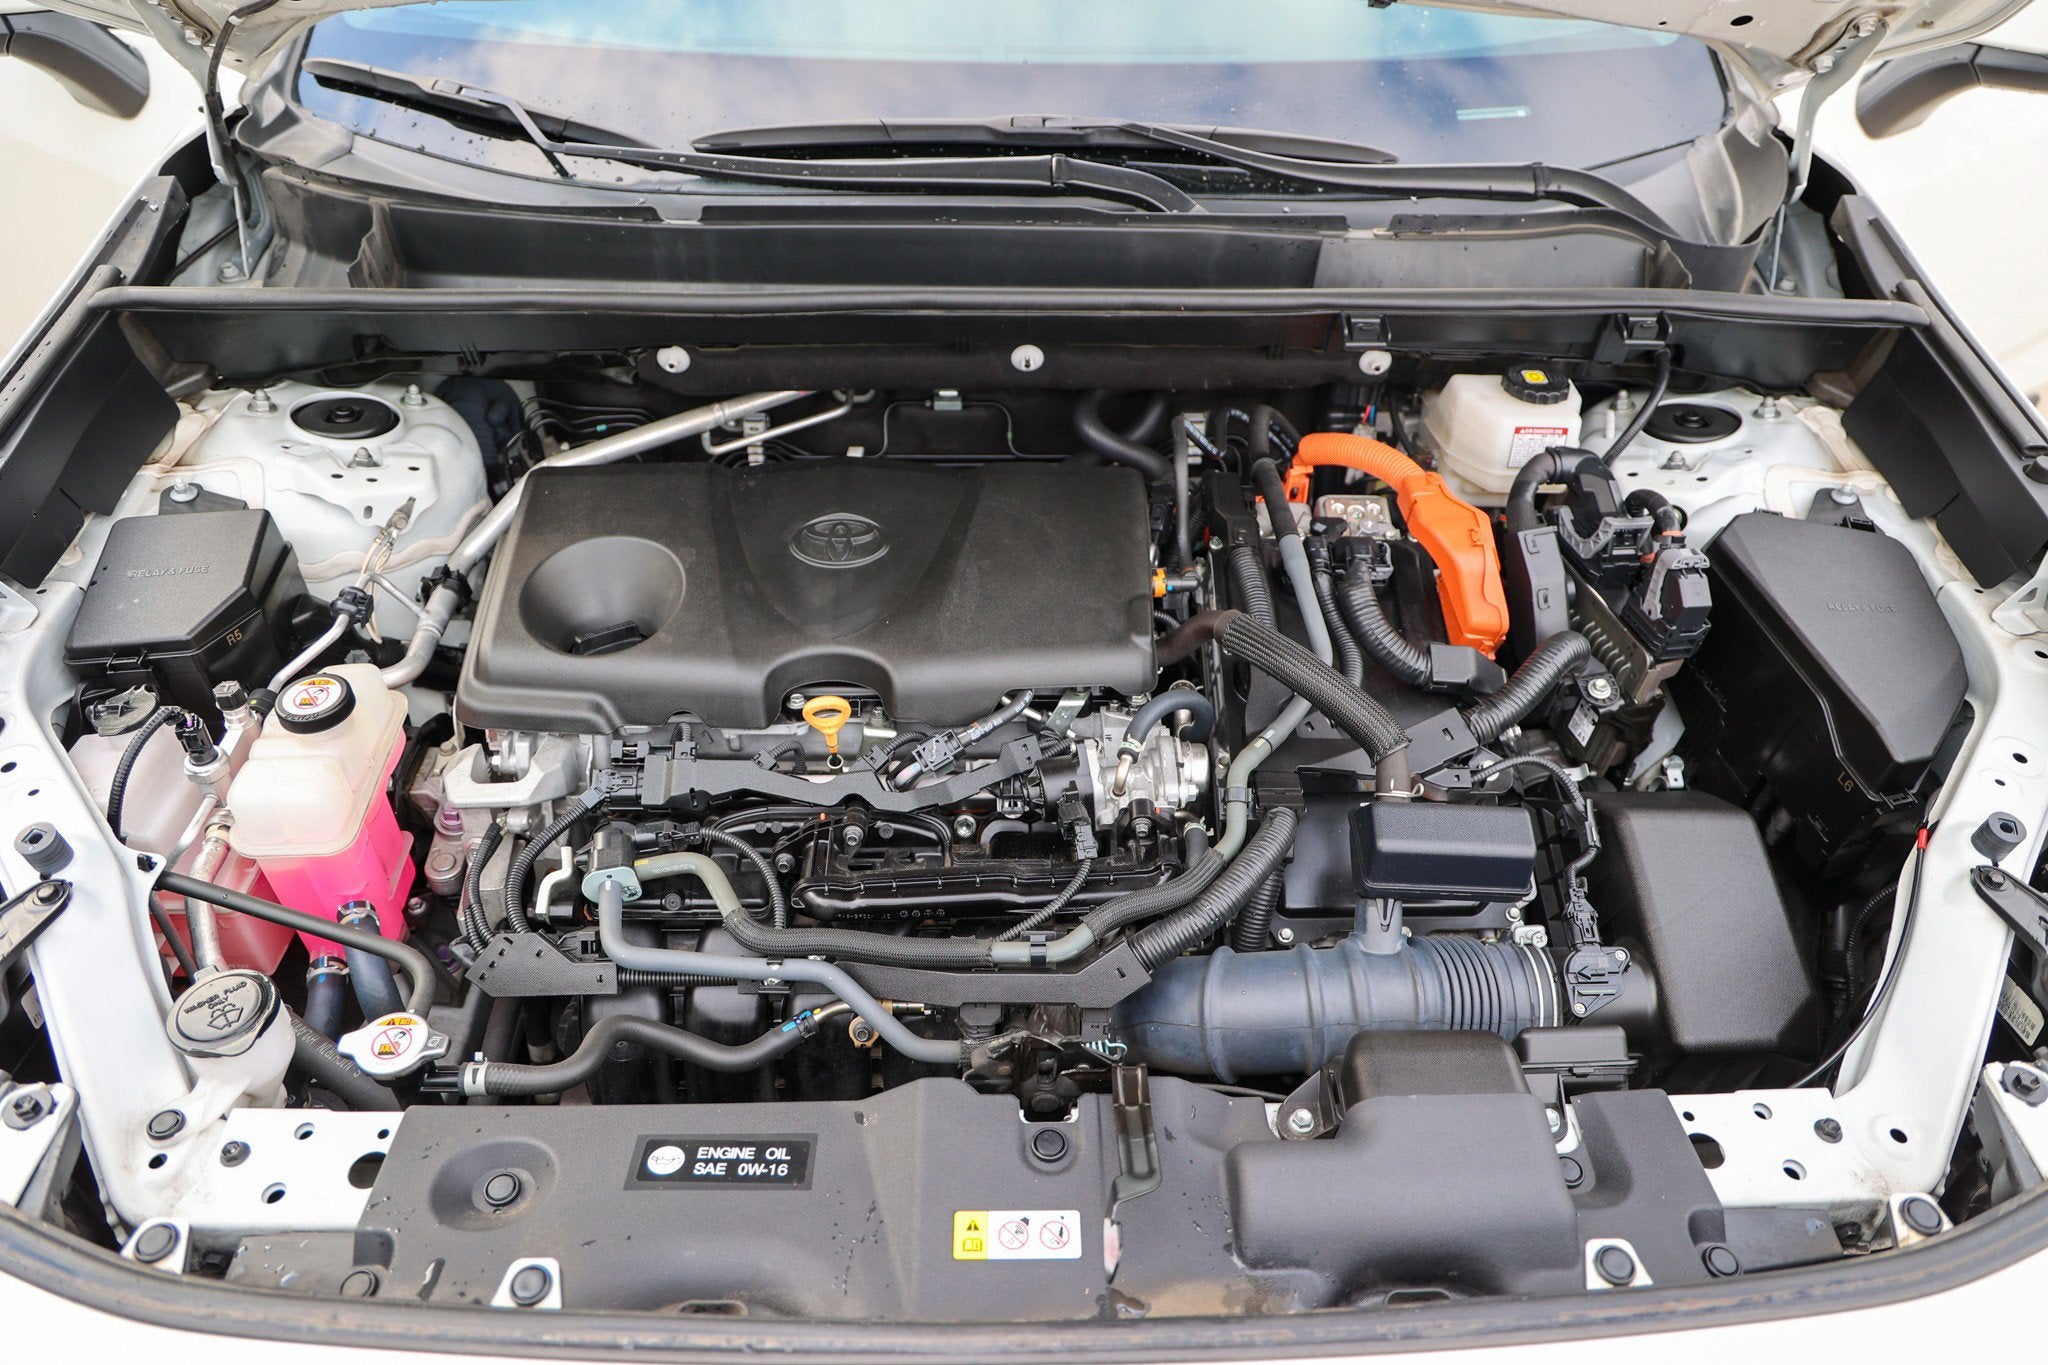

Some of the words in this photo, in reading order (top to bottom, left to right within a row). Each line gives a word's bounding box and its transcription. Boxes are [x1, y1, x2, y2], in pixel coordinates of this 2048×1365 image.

[179, 565, 209, 575] FUSE
[226, 628, 242, 646] R5
[1838, 771, 1853, 792] L6
[184, 994, 220, 1014] WASHER
[224, 981, 247, 995] FLUID
[207, 996, 229, 1010] ONLY
[697, 1147, 756, 1160] ENGINE
[765, 1147, 791, 1160] OIL
[693, 1162, 727, 1175] SAE
[738, 1163, 788, 1176] 0W-16
